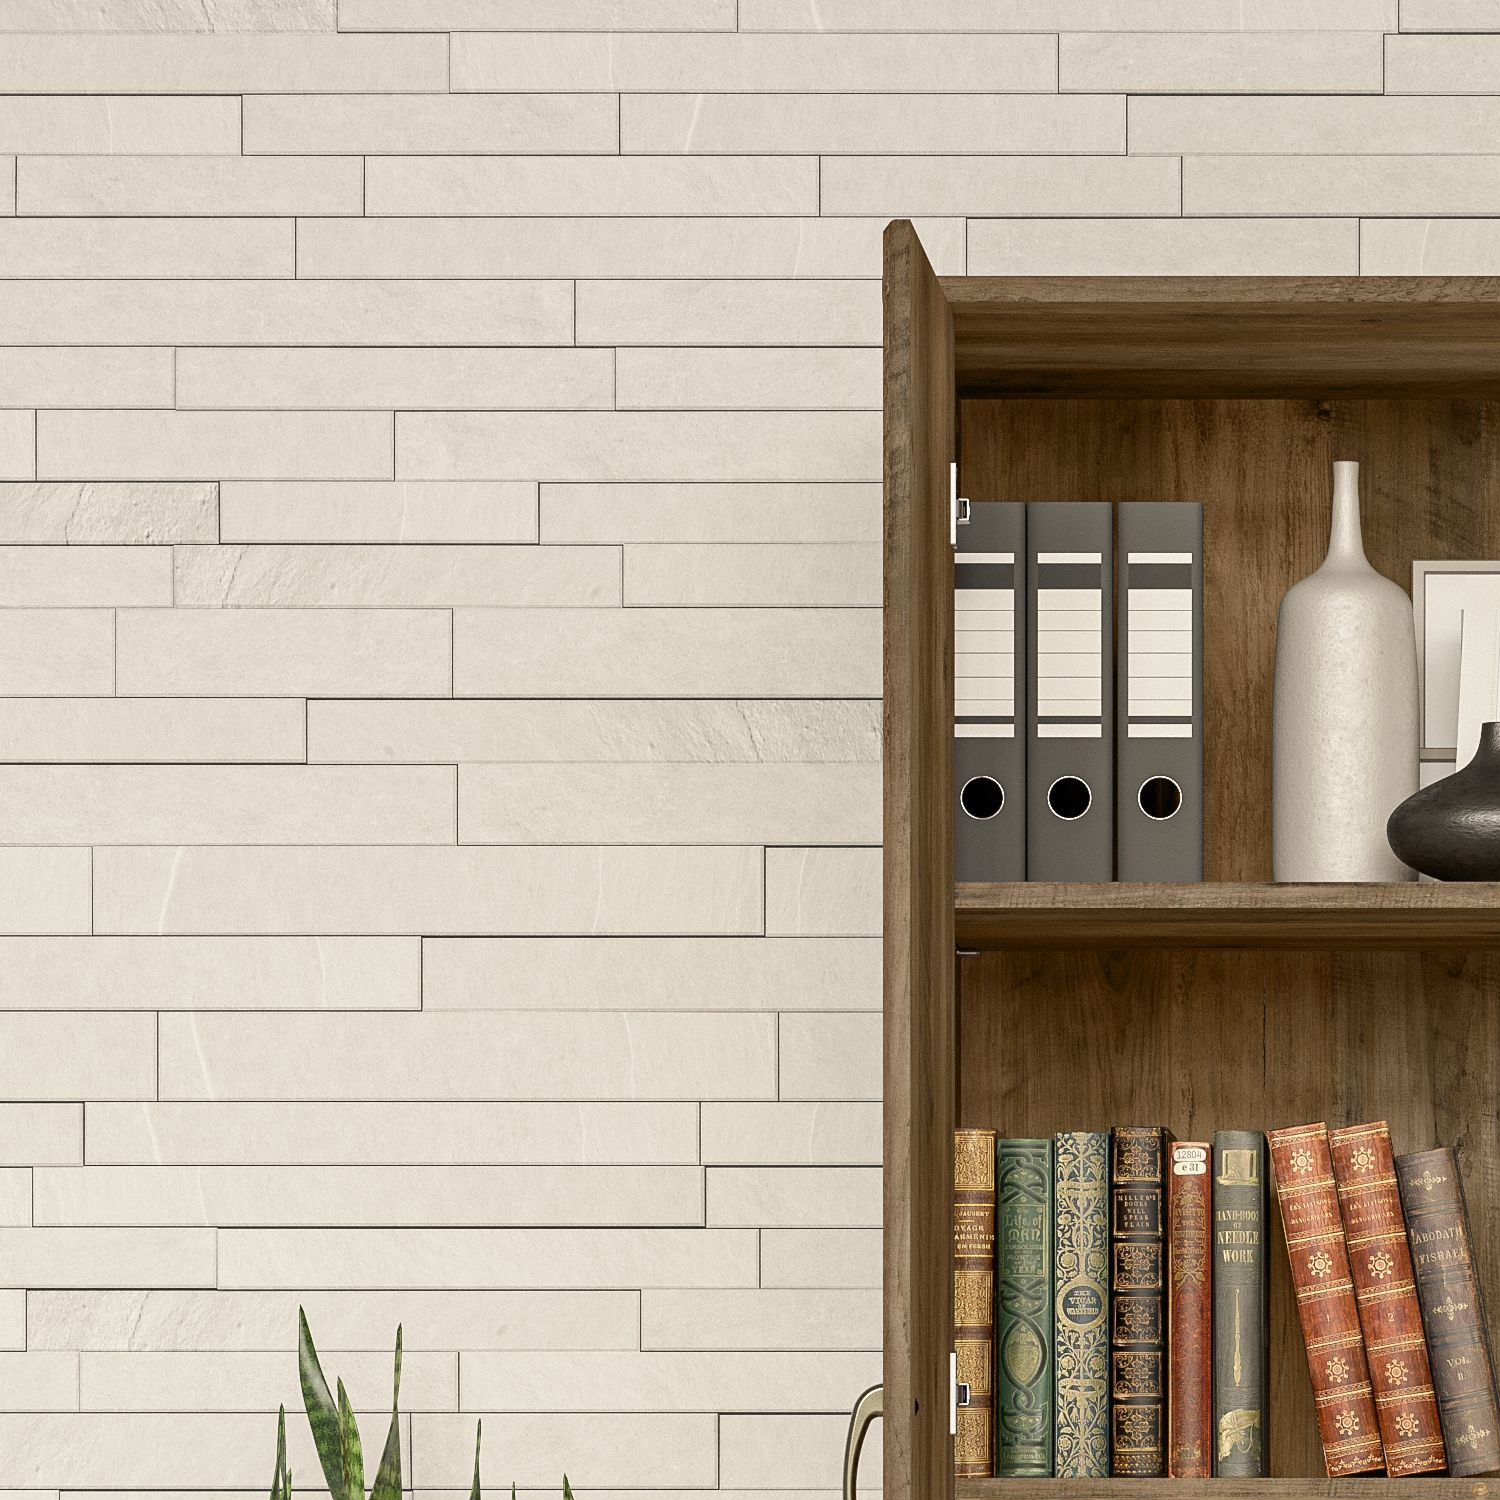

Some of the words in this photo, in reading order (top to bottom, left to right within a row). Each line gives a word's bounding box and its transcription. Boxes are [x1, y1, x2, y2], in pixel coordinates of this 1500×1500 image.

[1190, 1163, 1199, 1171] 31
[1217, 1230, 1259, 1244] NEEDLE
[1222, 1249, 1254, 1263] WORK
[1387, 1312, 1395, 1322] 2
